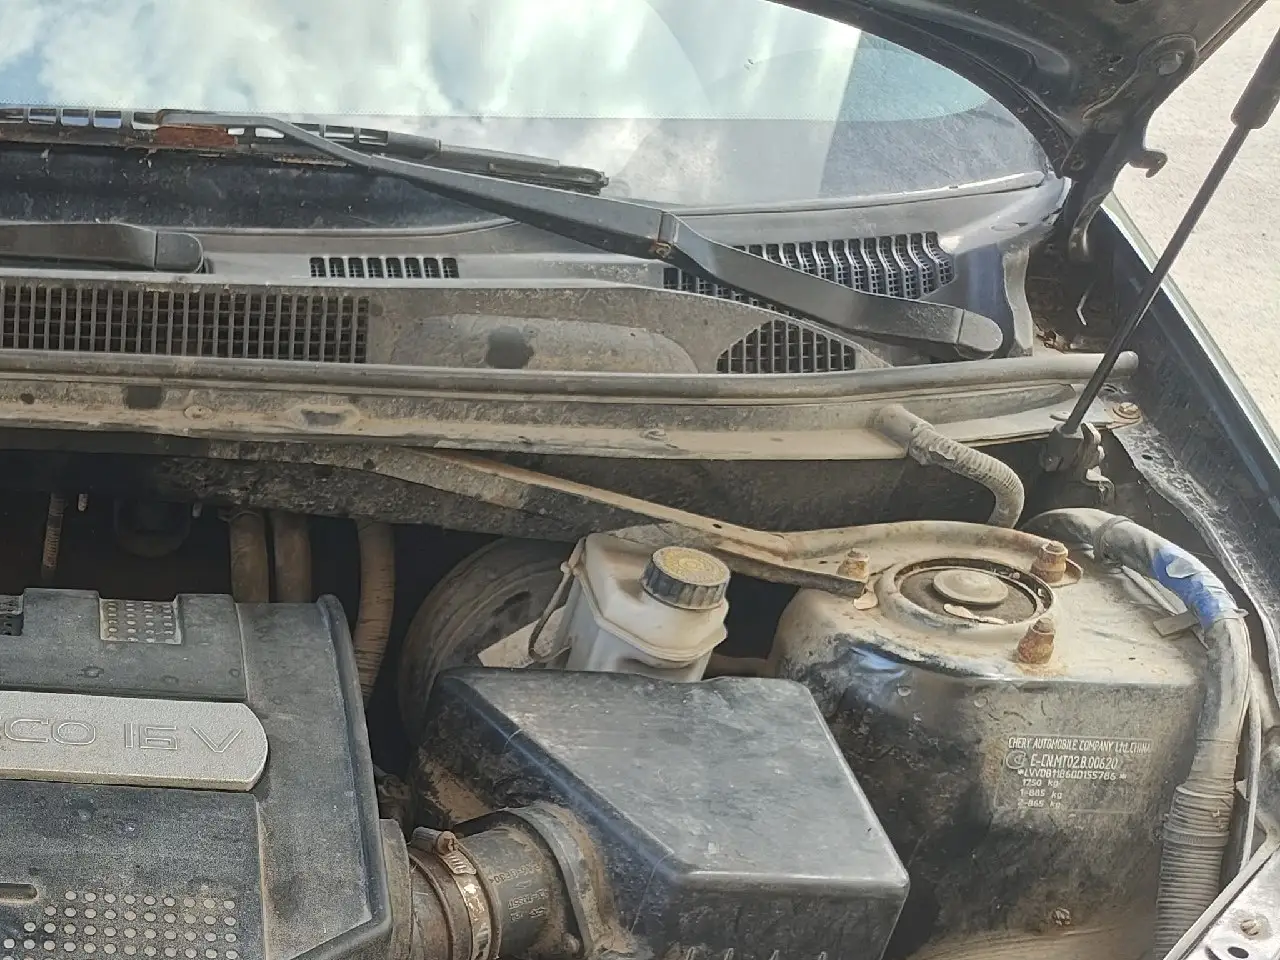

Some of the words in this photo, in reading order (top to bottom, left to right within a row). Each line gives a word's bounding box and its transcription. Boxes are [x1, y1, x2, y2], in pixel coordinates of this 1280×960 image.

[1008, 737, 1031, 749] CHERY
[1032, 738, 1078, 751] AUTOMOBILE
[1079, 740, 1114, 752] COMPANY
